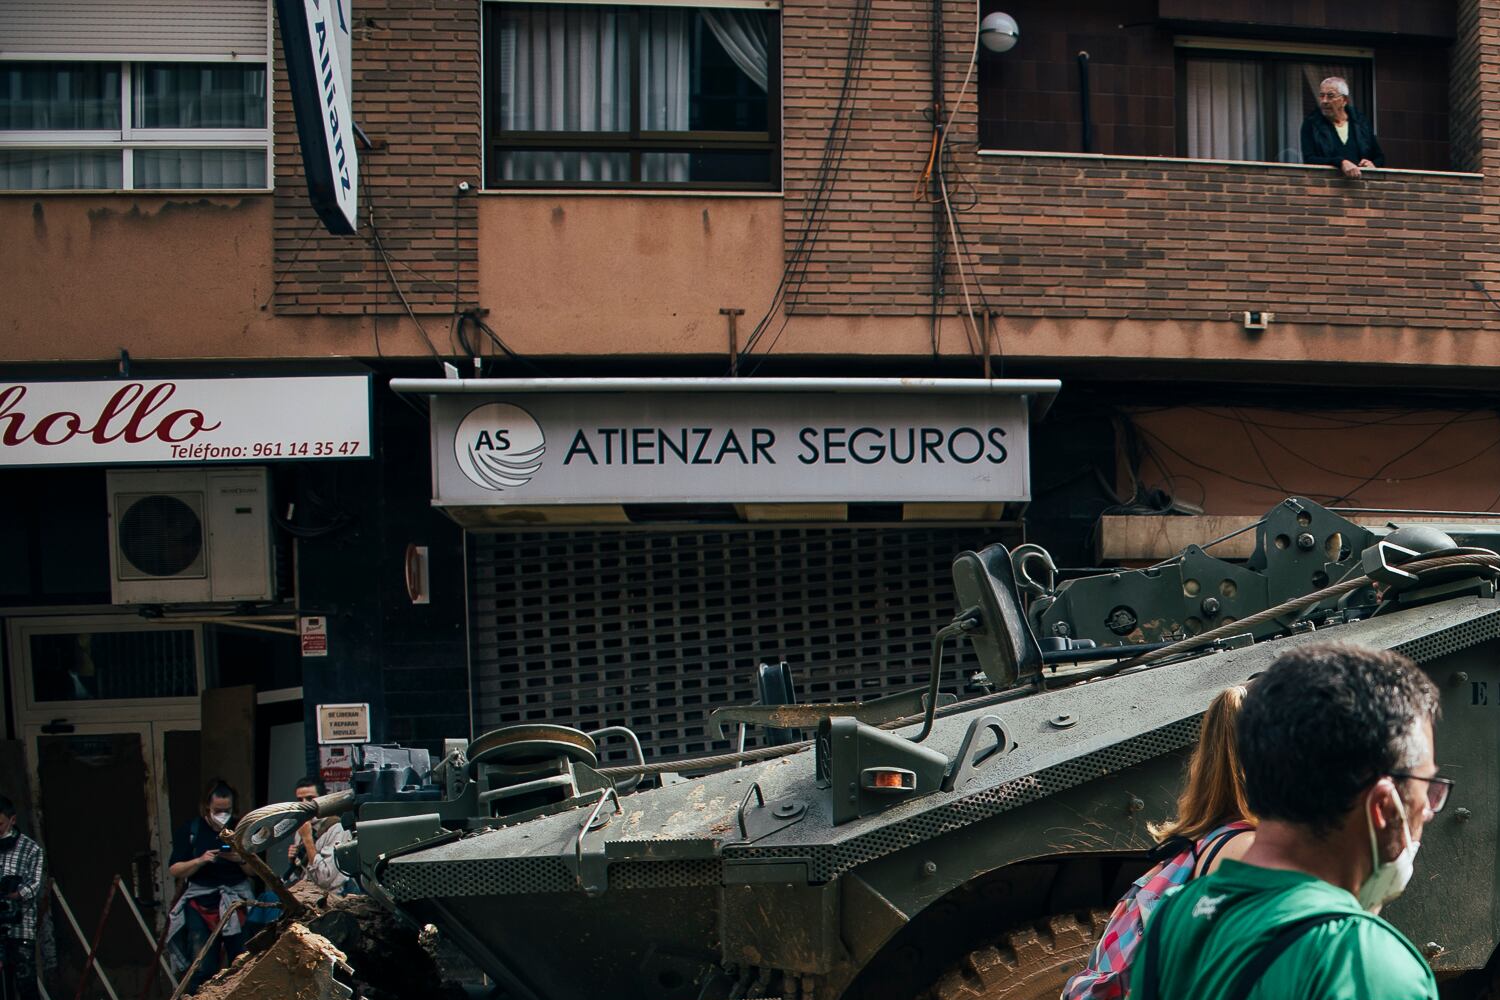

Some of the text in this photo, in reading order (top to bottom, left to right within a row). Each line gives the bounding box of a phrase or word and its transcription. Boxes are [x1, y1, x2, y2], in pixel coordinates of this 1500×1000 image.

[315, 16, 351, 201] Allianz
[170, 441, 360, 460] Teléfono: 961 14 35 47
[475, 426, 1008, 466] AS ATIENZAR SEGUROS
